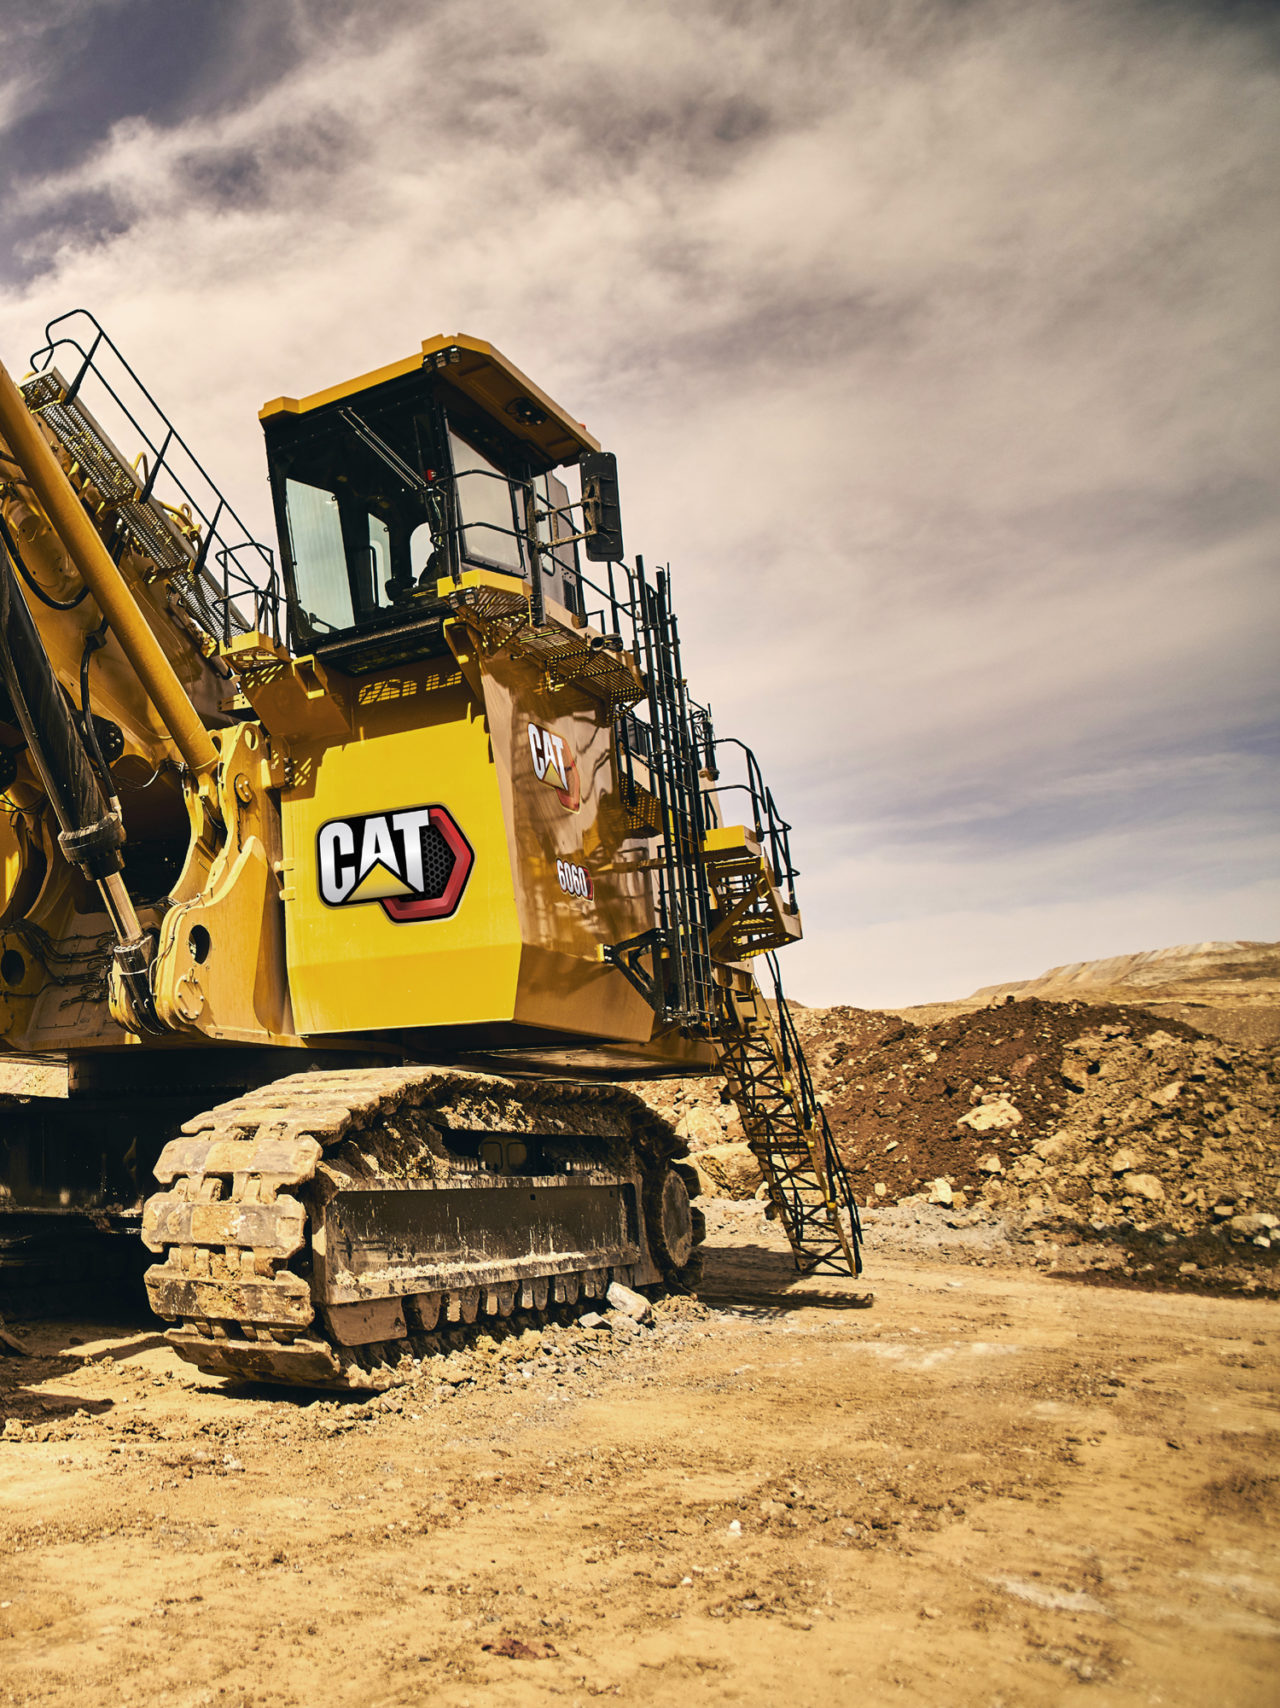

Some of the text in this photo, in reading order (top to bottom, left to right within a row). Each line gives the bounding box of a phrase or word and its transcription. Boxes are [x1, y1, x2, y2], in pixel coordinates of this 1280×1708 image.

[528, 723, 569, 791] CAT
[319, 809, 430, 904] CAT
[556, 859, 588, 897] 6060
